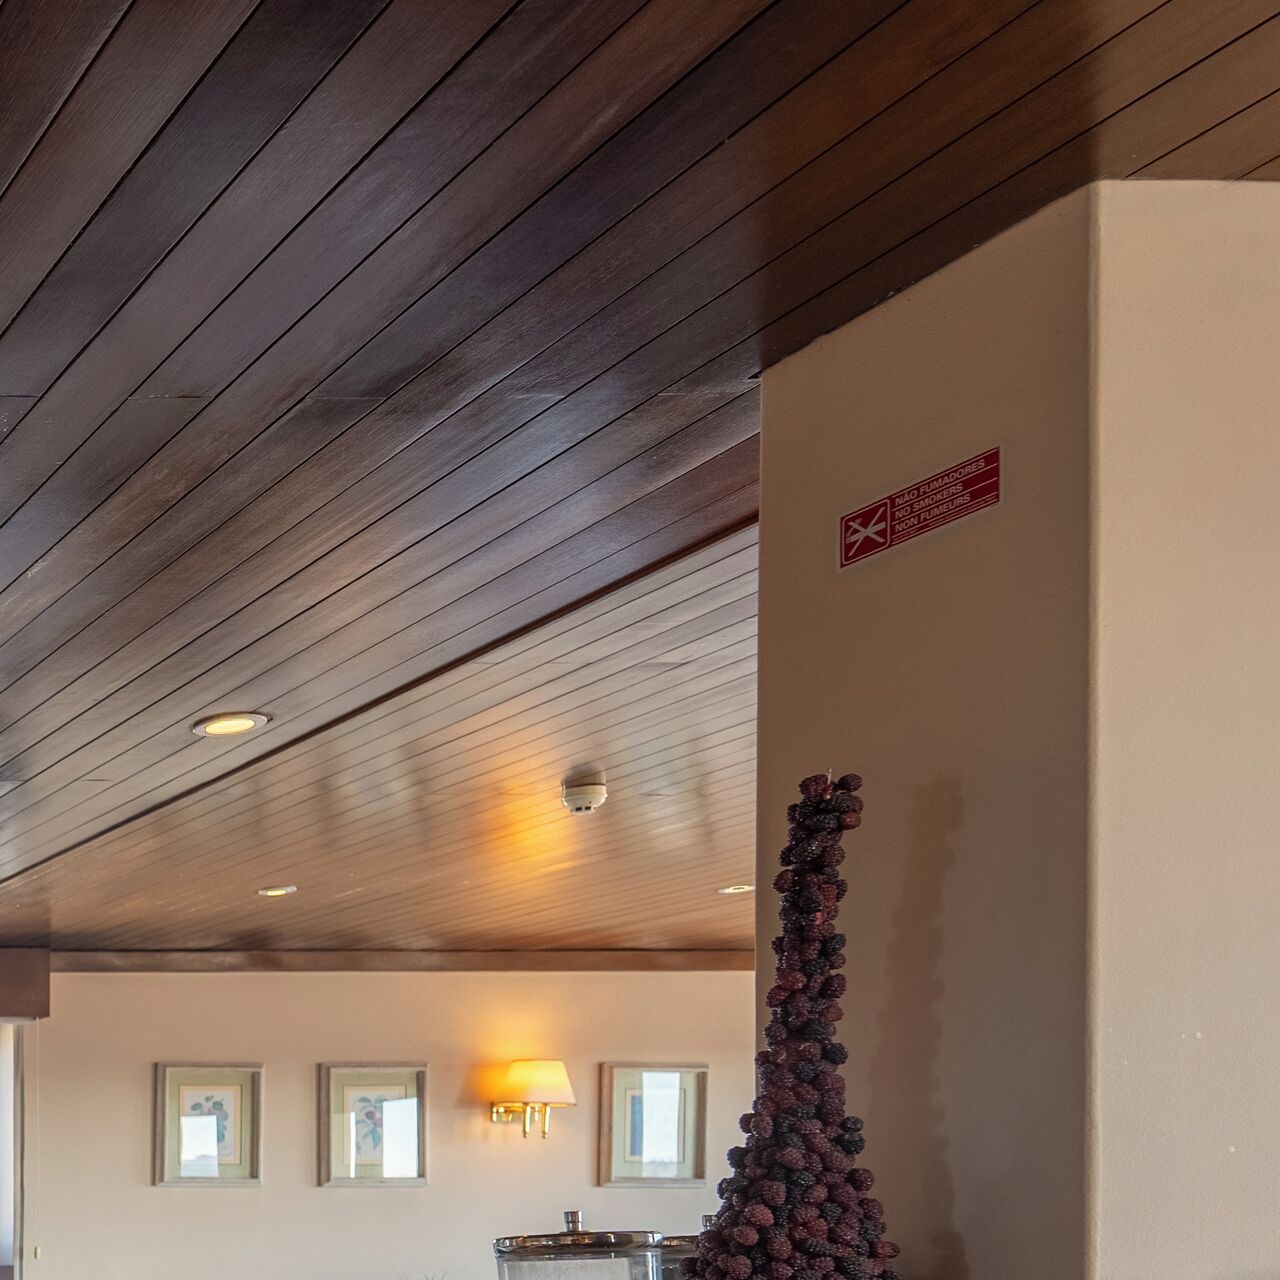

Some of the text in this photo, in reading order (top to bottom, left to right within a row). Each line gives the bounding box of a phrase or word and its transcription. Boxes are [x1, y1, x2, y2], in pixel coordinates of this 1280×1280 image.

[895, 459, 986, 506] NÃO FUMADORES
[895, 505, 911, 519] NO
[913, 483, 963, 511] SMOKERS
[895, 517, 918, 533] NON
[920, 493, 971, 523] FUMEURS
